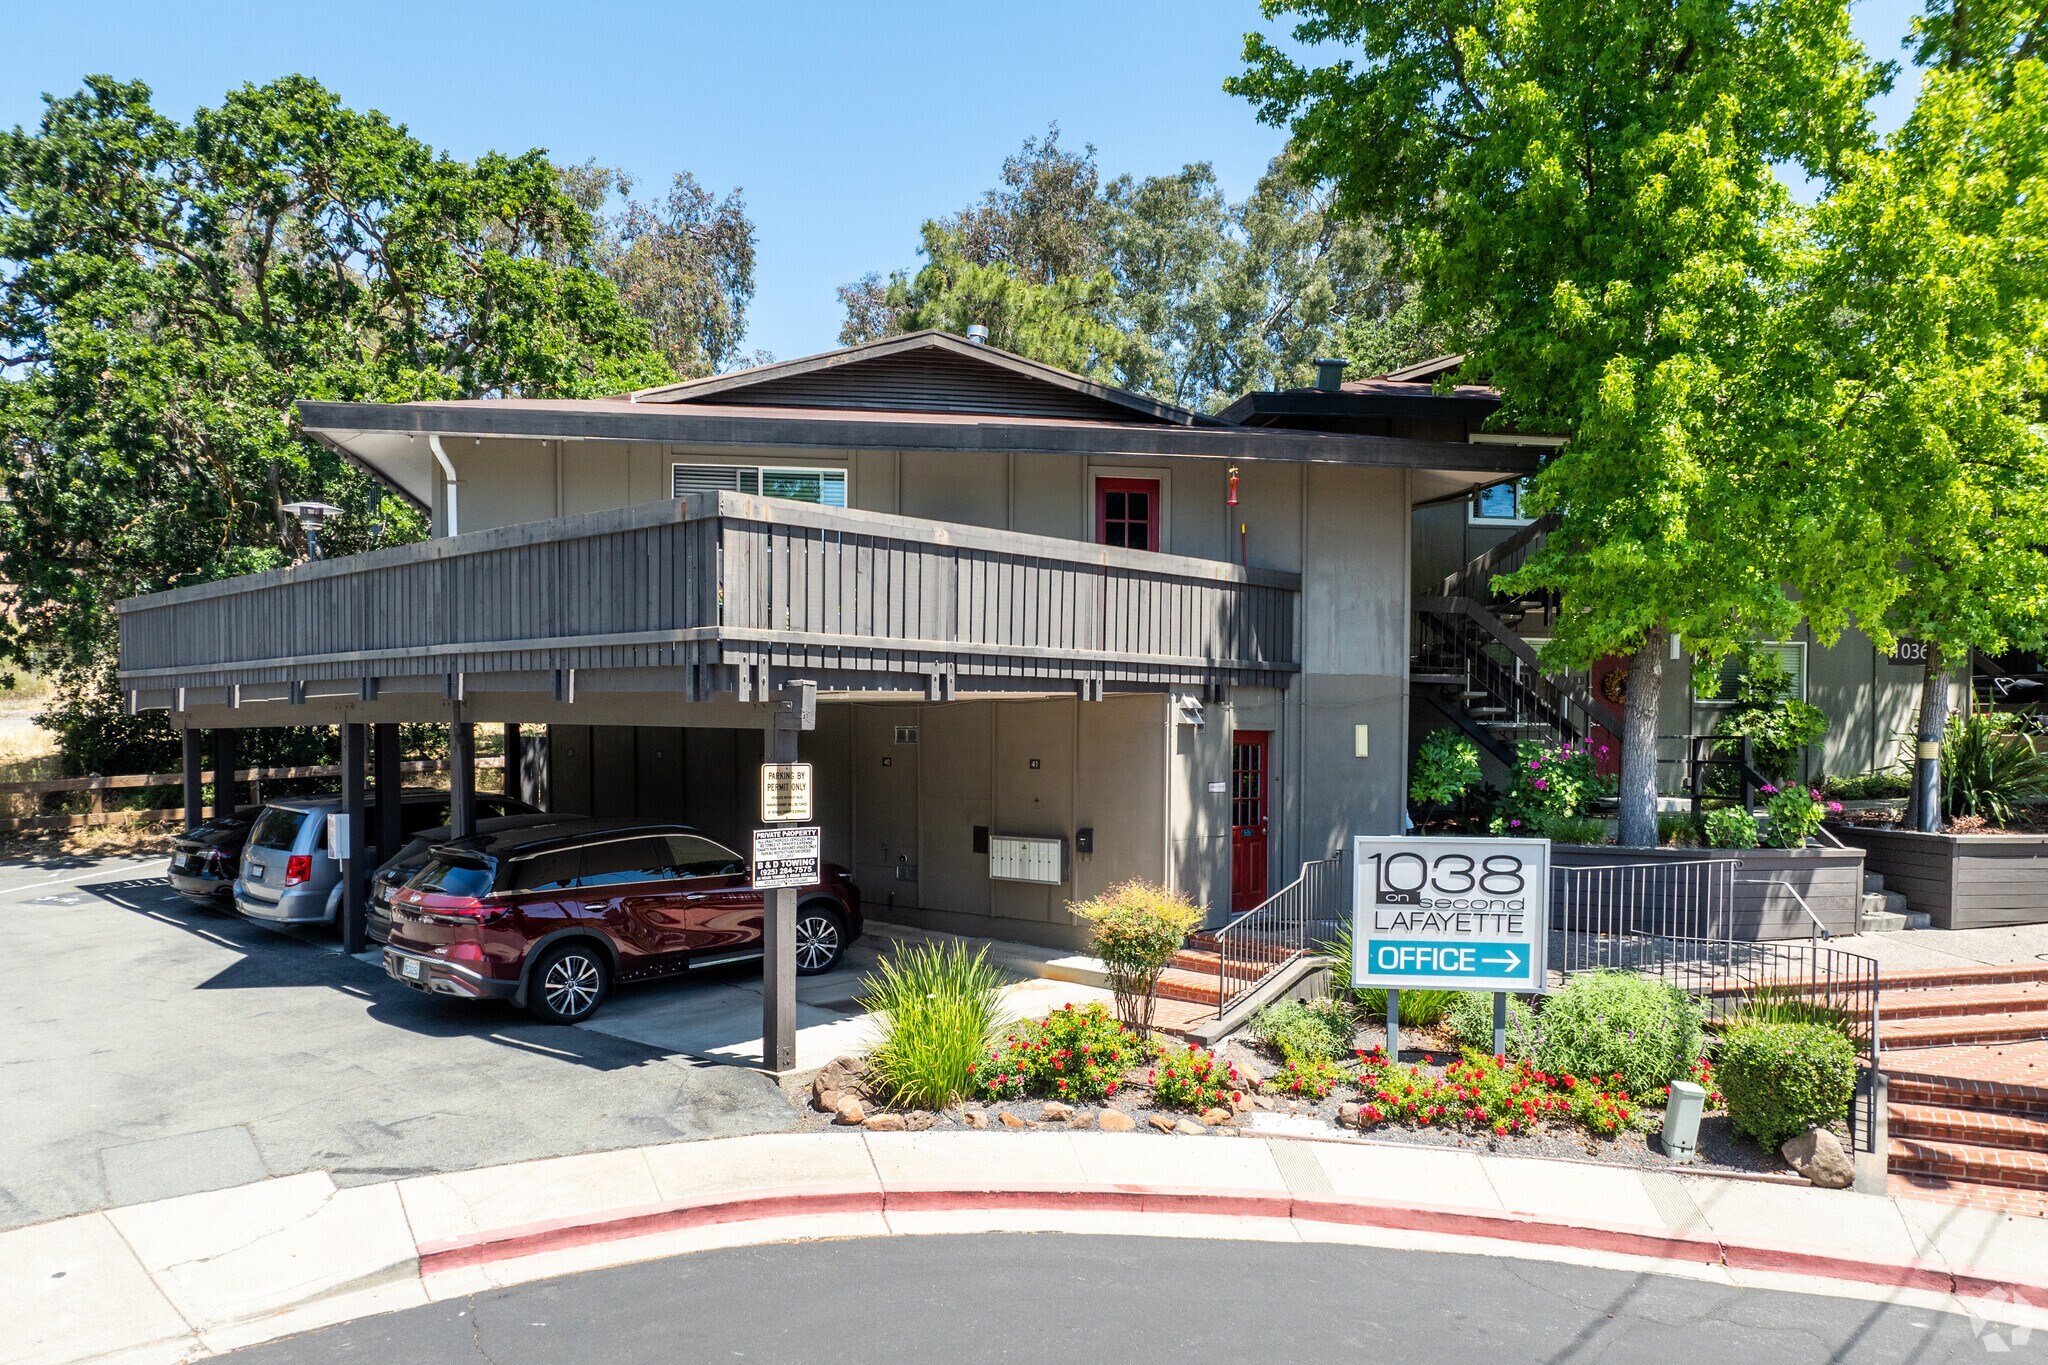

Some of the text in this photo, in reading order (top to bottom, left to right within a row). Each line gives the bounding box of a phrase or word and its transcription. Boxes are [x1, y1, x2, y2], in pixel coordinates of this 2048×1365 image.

[779, 866, 812, 874] 284-7575
[781, 858, 815, 867] TOWING
[1368, 852, 1525, 895] 1038
[1385, 892, 1524, 910] on second
[1375, 911, 1524, 933] LAFAYETTE
[1378, 946, 1476, 971] OFFICE
